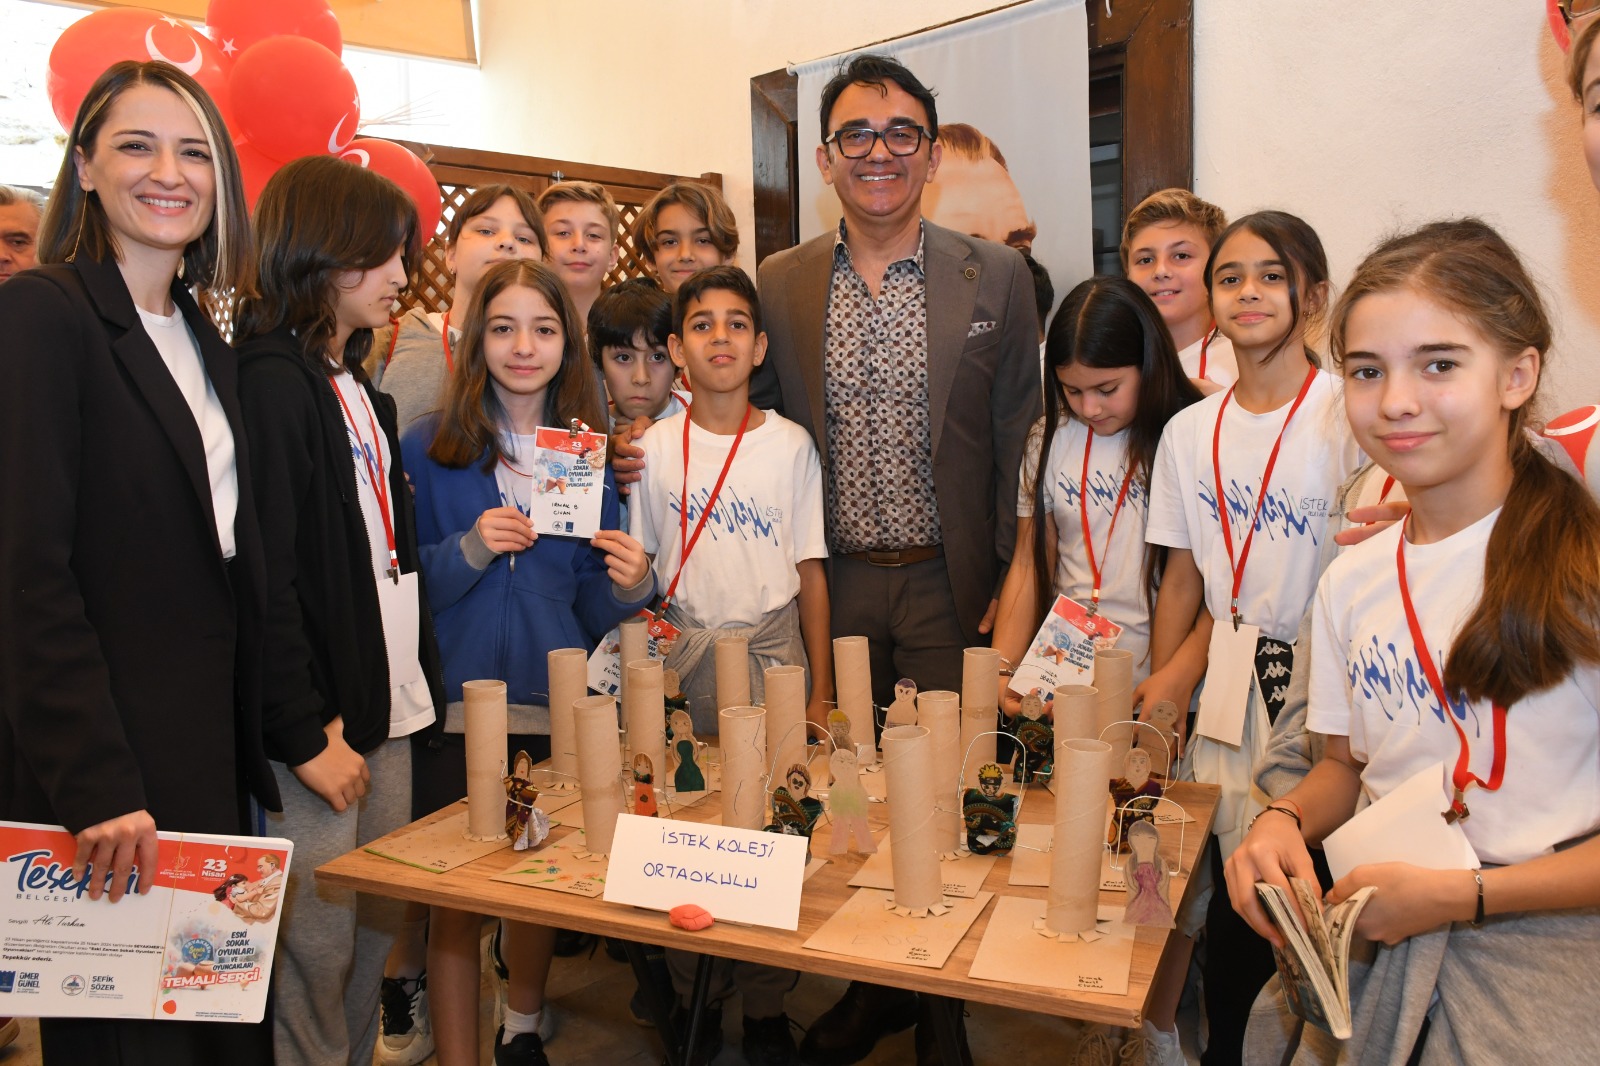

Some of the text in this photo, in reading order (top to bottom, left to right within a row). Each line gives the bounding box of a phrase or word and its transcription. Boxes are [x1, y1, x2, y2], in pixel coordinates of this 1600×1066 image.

[662, 826, 776, 858] İSTEK KOLEJİ
[203, 858, 228, 872] 23
[201, 870, 226, 878] Nisan
[643, 862, 758, 889] ORTAOKULU
[16, 893, 75, 903] BELGESİ
[231, 929, 248, 939] ESKİ
[225, 939, 250, 947] SOKAK
[217, 947, 255, 957] OYUNLARI
[212, 962, 254, 971] OYUNCAKLARI
[92, 975, 114, 983] ŞEFİK
[164, 967, 260, 988] TEMALI SERGİ
[91, 983, 115, 991] SÖZER
